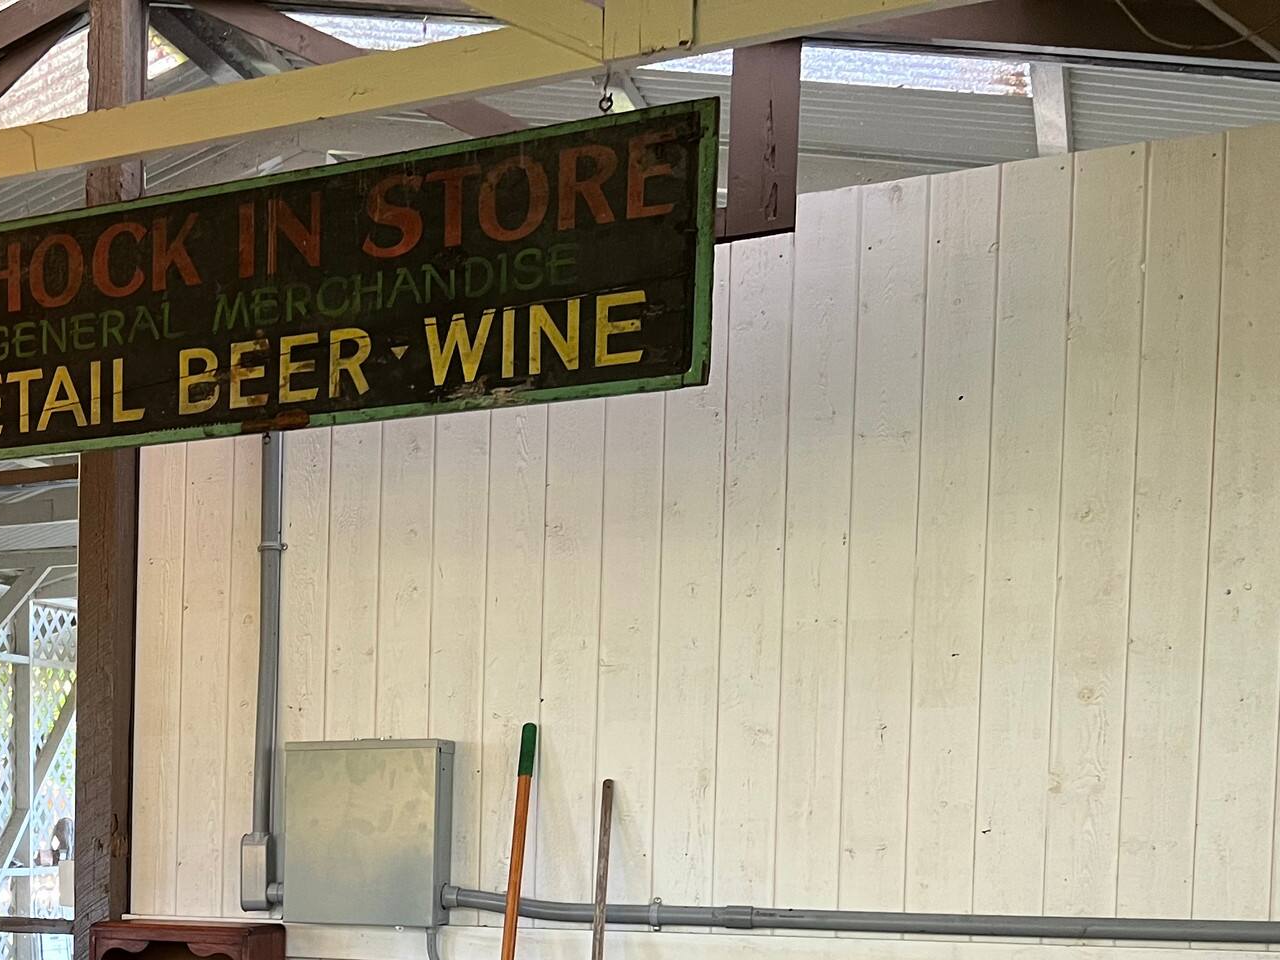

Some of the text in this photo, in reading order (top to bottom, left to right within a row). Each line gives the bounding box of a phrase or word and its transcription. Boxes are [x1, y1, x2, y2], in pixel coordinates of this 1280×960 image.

[238, 190, 322, 279] IN
[362, 130, 677, 259] STORE
[212, 243, 579, 335] MERCHANDISE
[178, 327, 373, 416] BEER
[424, 290, 646, 387] WINE
